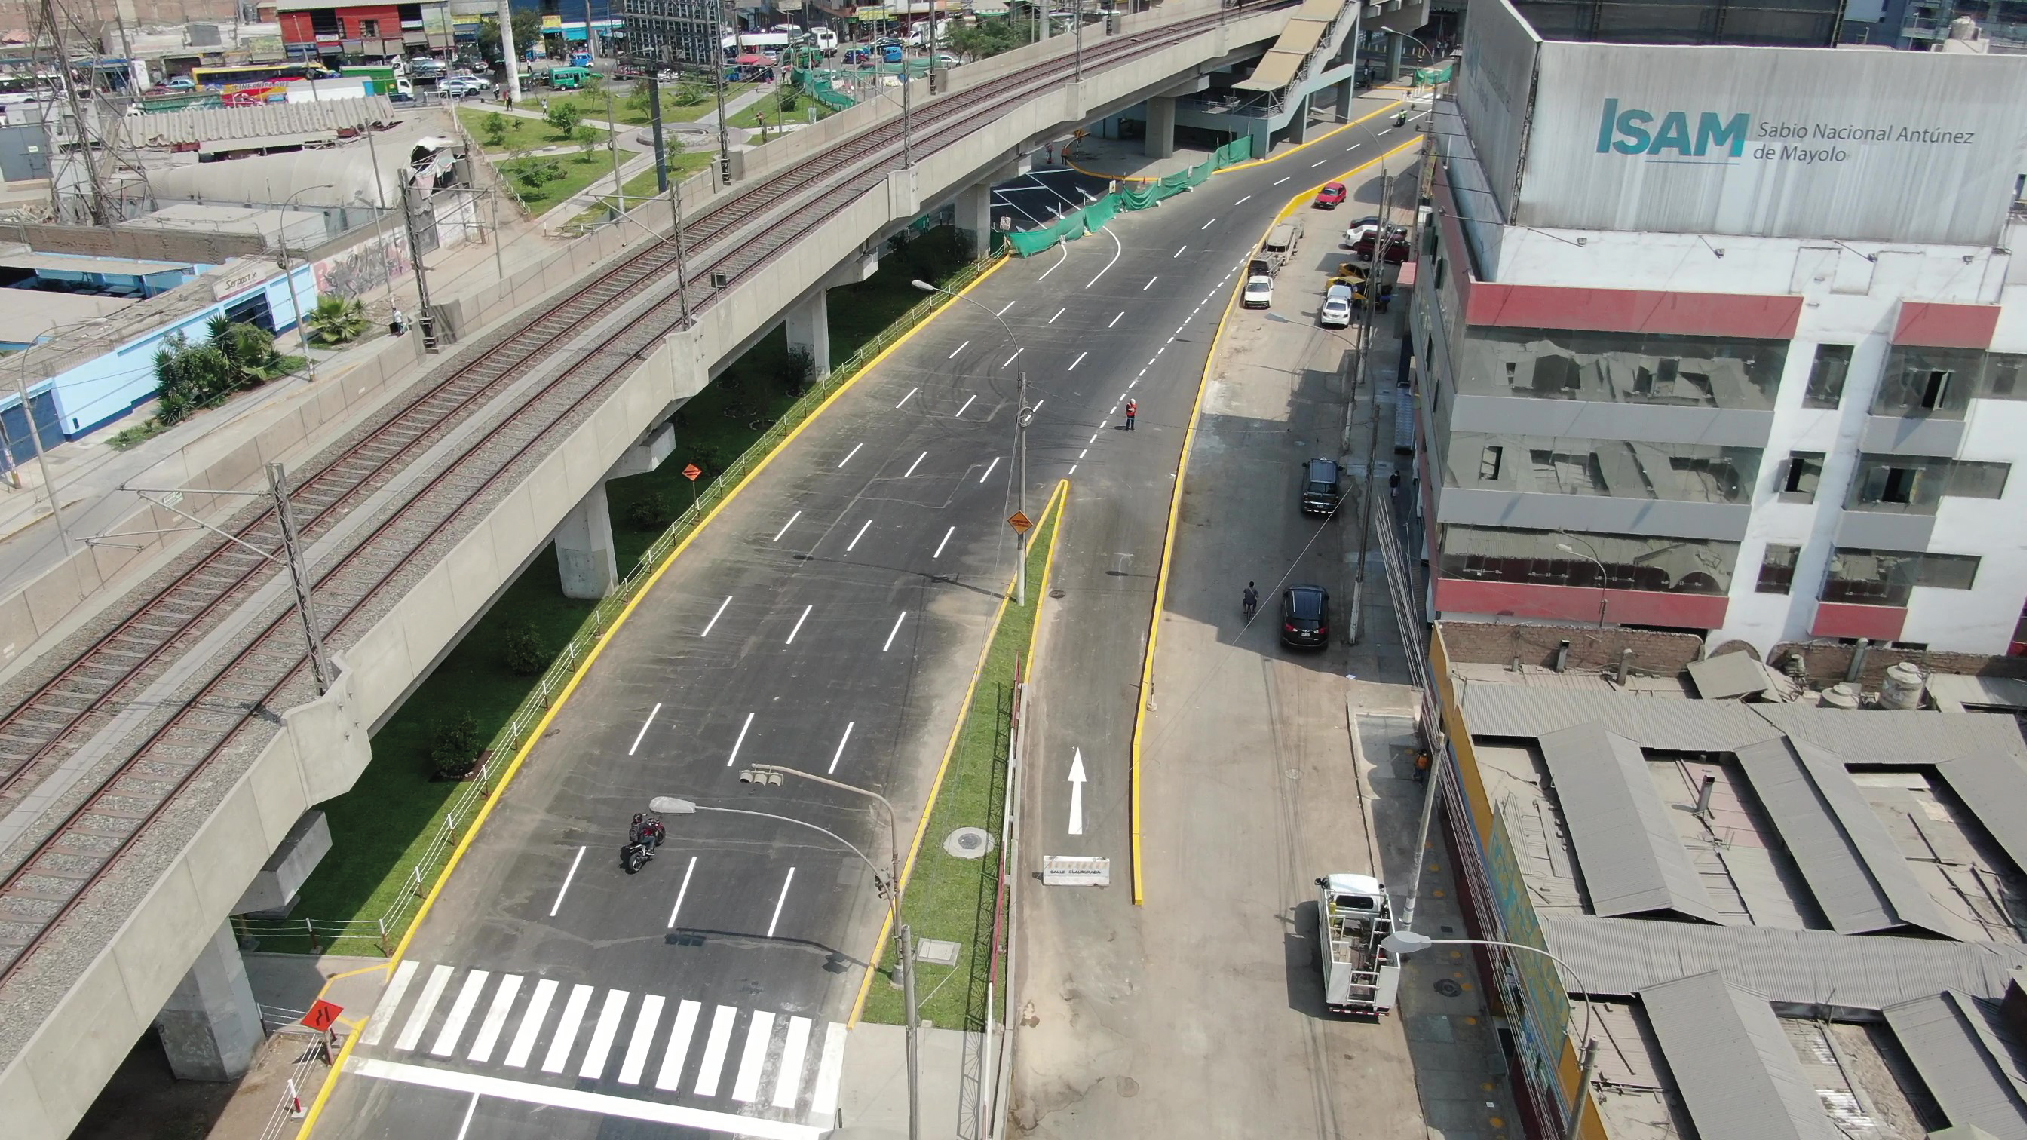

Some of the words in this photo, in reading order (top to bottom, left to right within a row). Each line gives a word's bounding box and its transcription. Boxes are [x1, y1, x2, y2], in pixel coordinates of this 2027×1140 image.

[1596, 98, 1750, 158] ISAM
[1757, 121, 1808, 140] Sabio
[1812, 123, 1894, 142] Nacional
[1895, 126, 1975, 145] Antúnez
[1753, 144, 1776, 161] de
[1780, 145, 1847, 165] Mayolo
